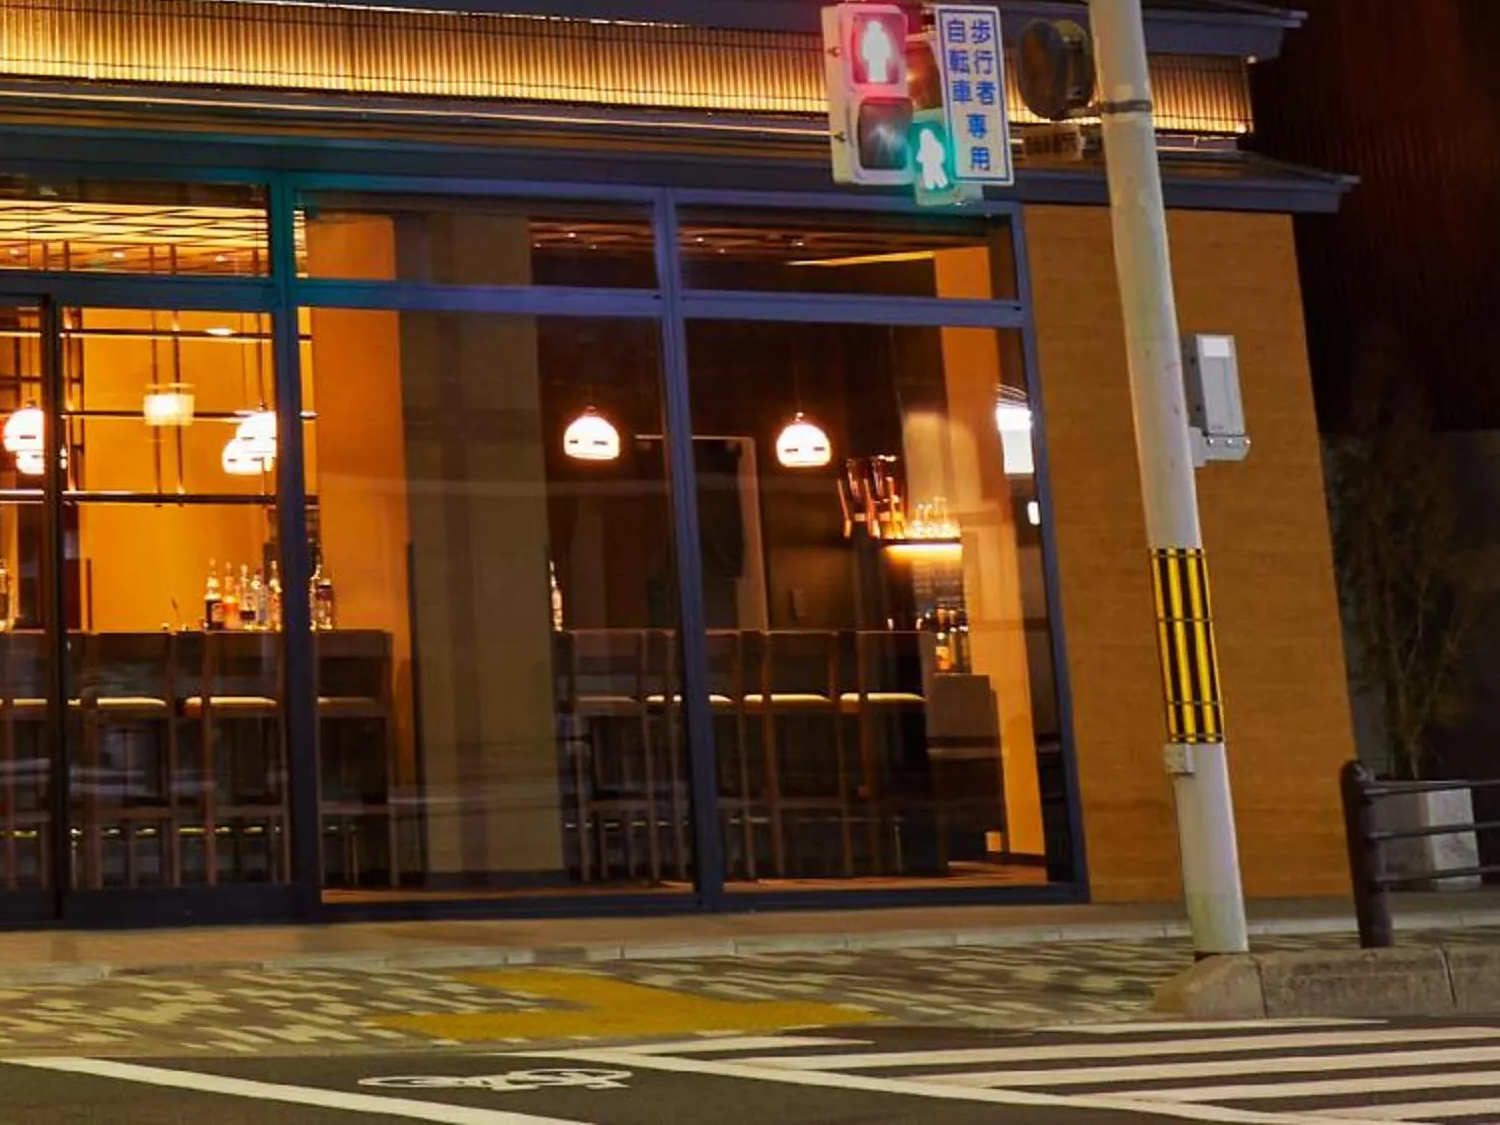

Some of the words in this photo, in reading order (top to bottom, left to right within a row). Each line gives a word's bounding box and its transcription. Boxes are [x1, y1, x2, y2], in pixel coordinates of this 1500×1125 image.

[948, 18, 973, 105] 自転車
[970, 18, 997, 106] 歩行者
[966, 113, 991, 172] 専用
